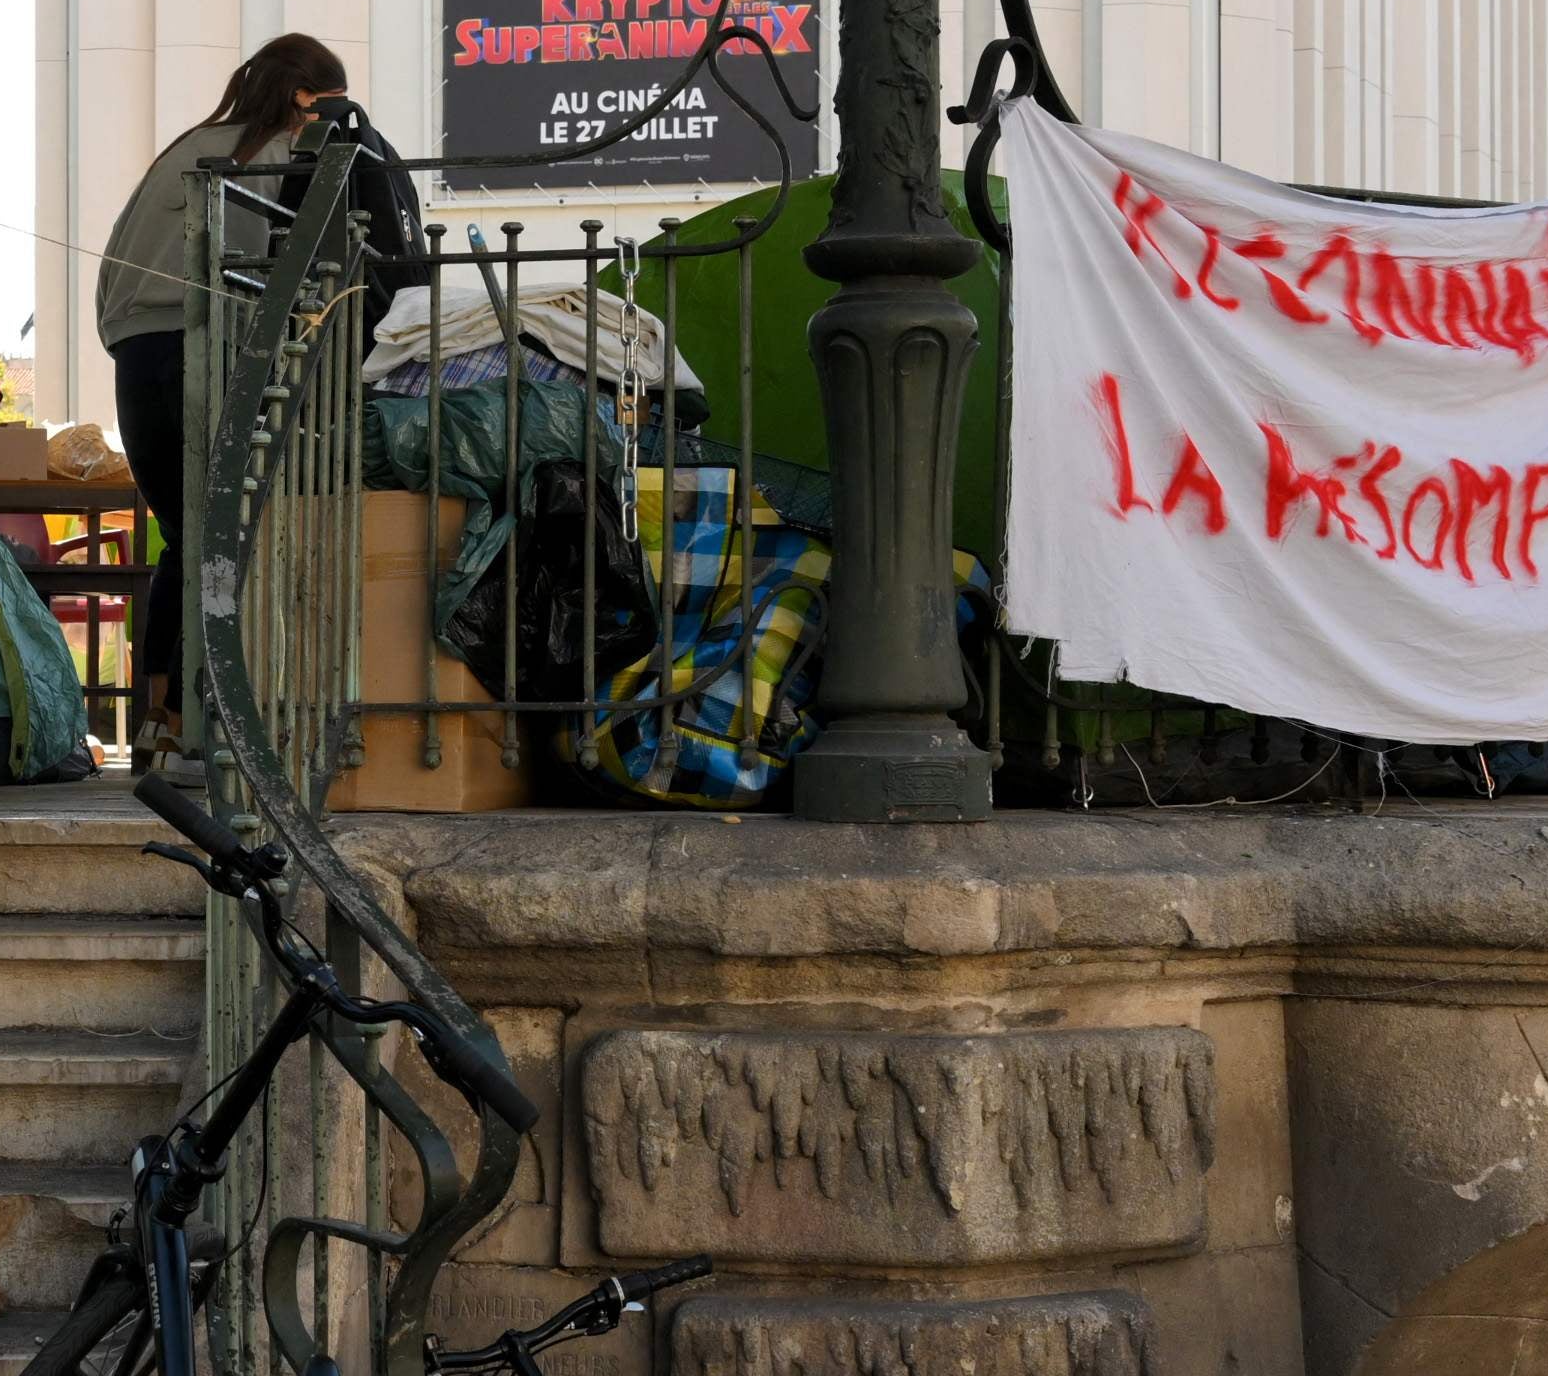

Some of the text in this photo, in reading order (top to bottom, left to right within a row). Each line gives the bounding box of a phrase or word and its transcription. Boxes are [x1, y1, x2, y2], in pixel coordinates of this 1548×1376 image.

[551, 92, 588, 115] AU
[540, 122, 570, 144] LE
[576, 121, 605, 143] 27
[1089, 371, 1229, 537] LA
